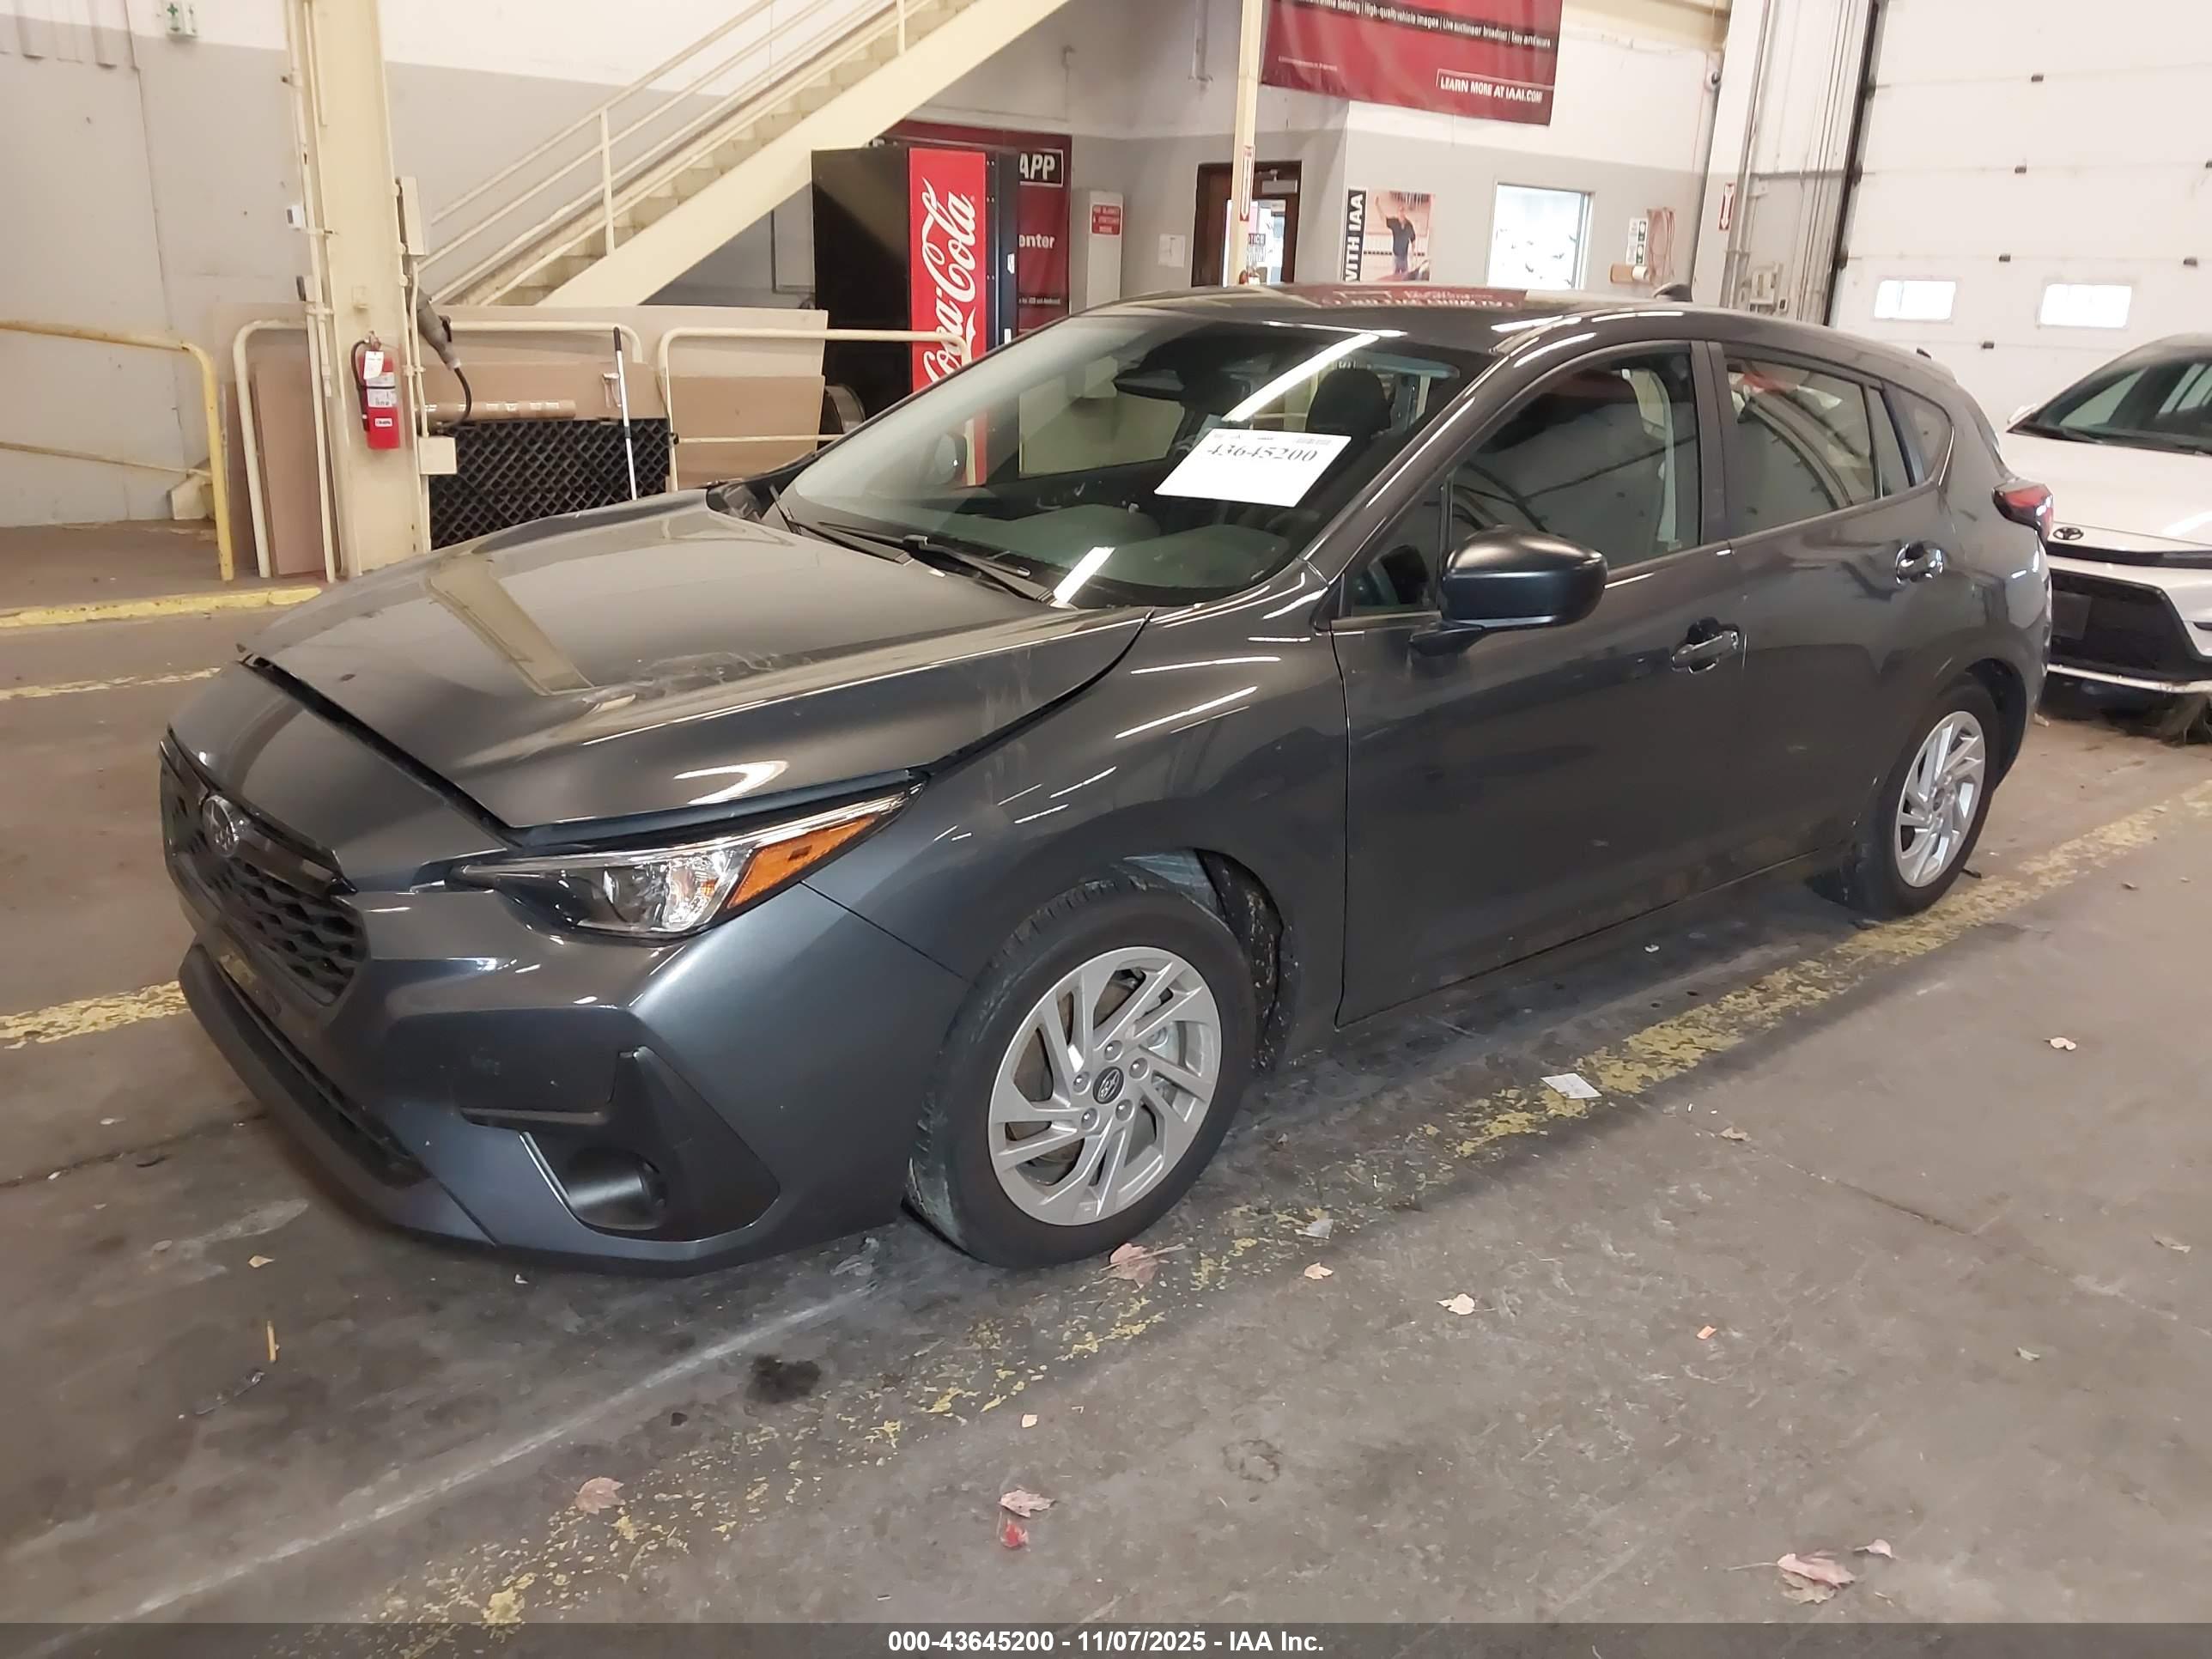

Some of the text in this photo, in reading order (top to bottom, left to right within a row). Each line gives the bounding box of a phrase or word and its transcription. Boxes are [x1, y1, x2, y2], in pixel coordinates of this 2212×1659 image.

[1417, 14, 1438, 29] images
[1443, 18, 1454, 30] Live
[1441, 76, 1543, 104] LEARN MORE AT IAAI.COM
[1019, 153, 1055, 180] APP
[1349, 194, 1364, 231] IAA
[1018, 234, 1055, 248] enter
[1207, 444, 1317, 462] 43645200
